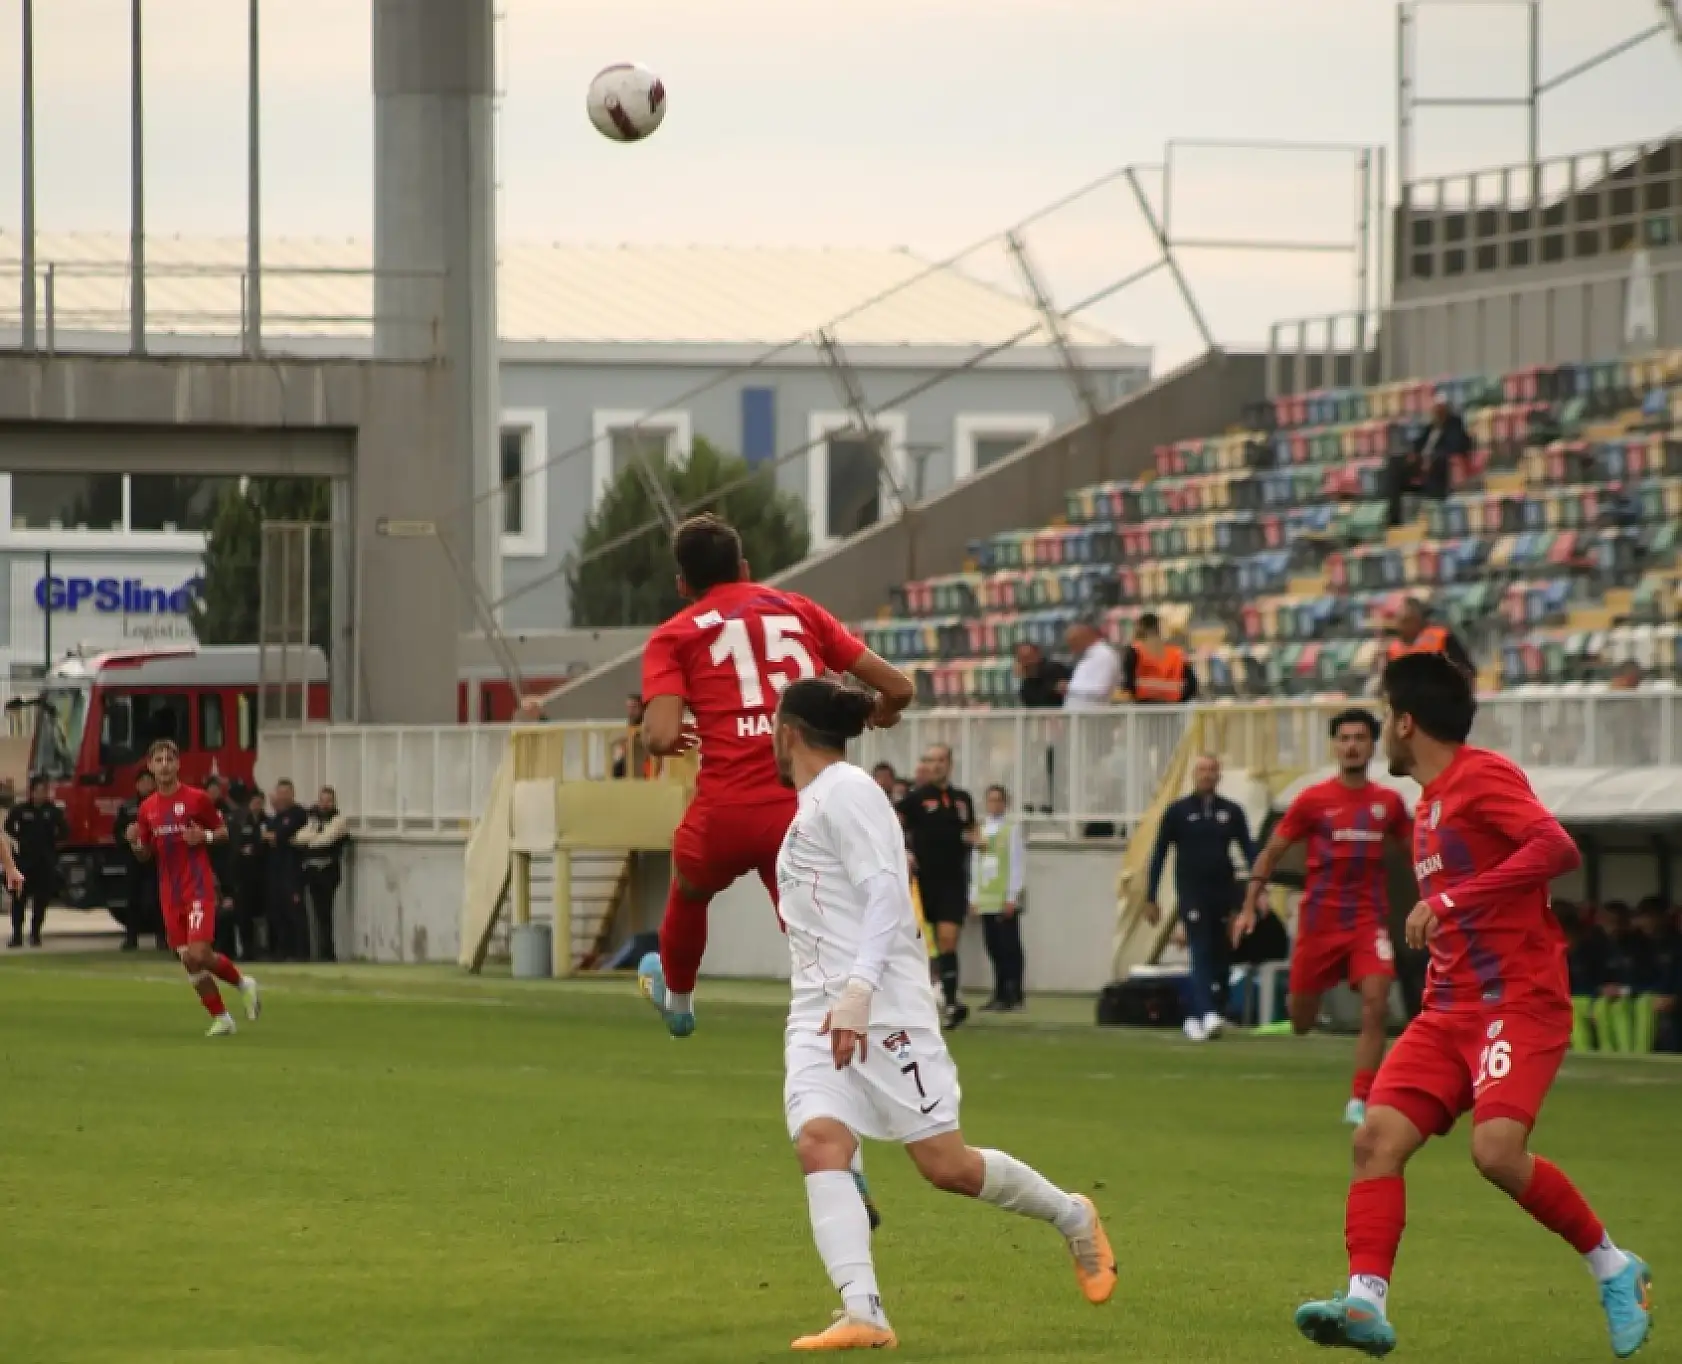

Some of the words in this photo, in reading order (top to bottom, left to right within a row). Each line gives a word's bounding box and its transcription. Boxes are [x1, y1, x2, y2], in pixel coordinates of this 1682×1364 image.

[709, 616, 815, 709] 15
[737, 713, 776, 737] HA
[900, 1061, 926, 1098] 7
